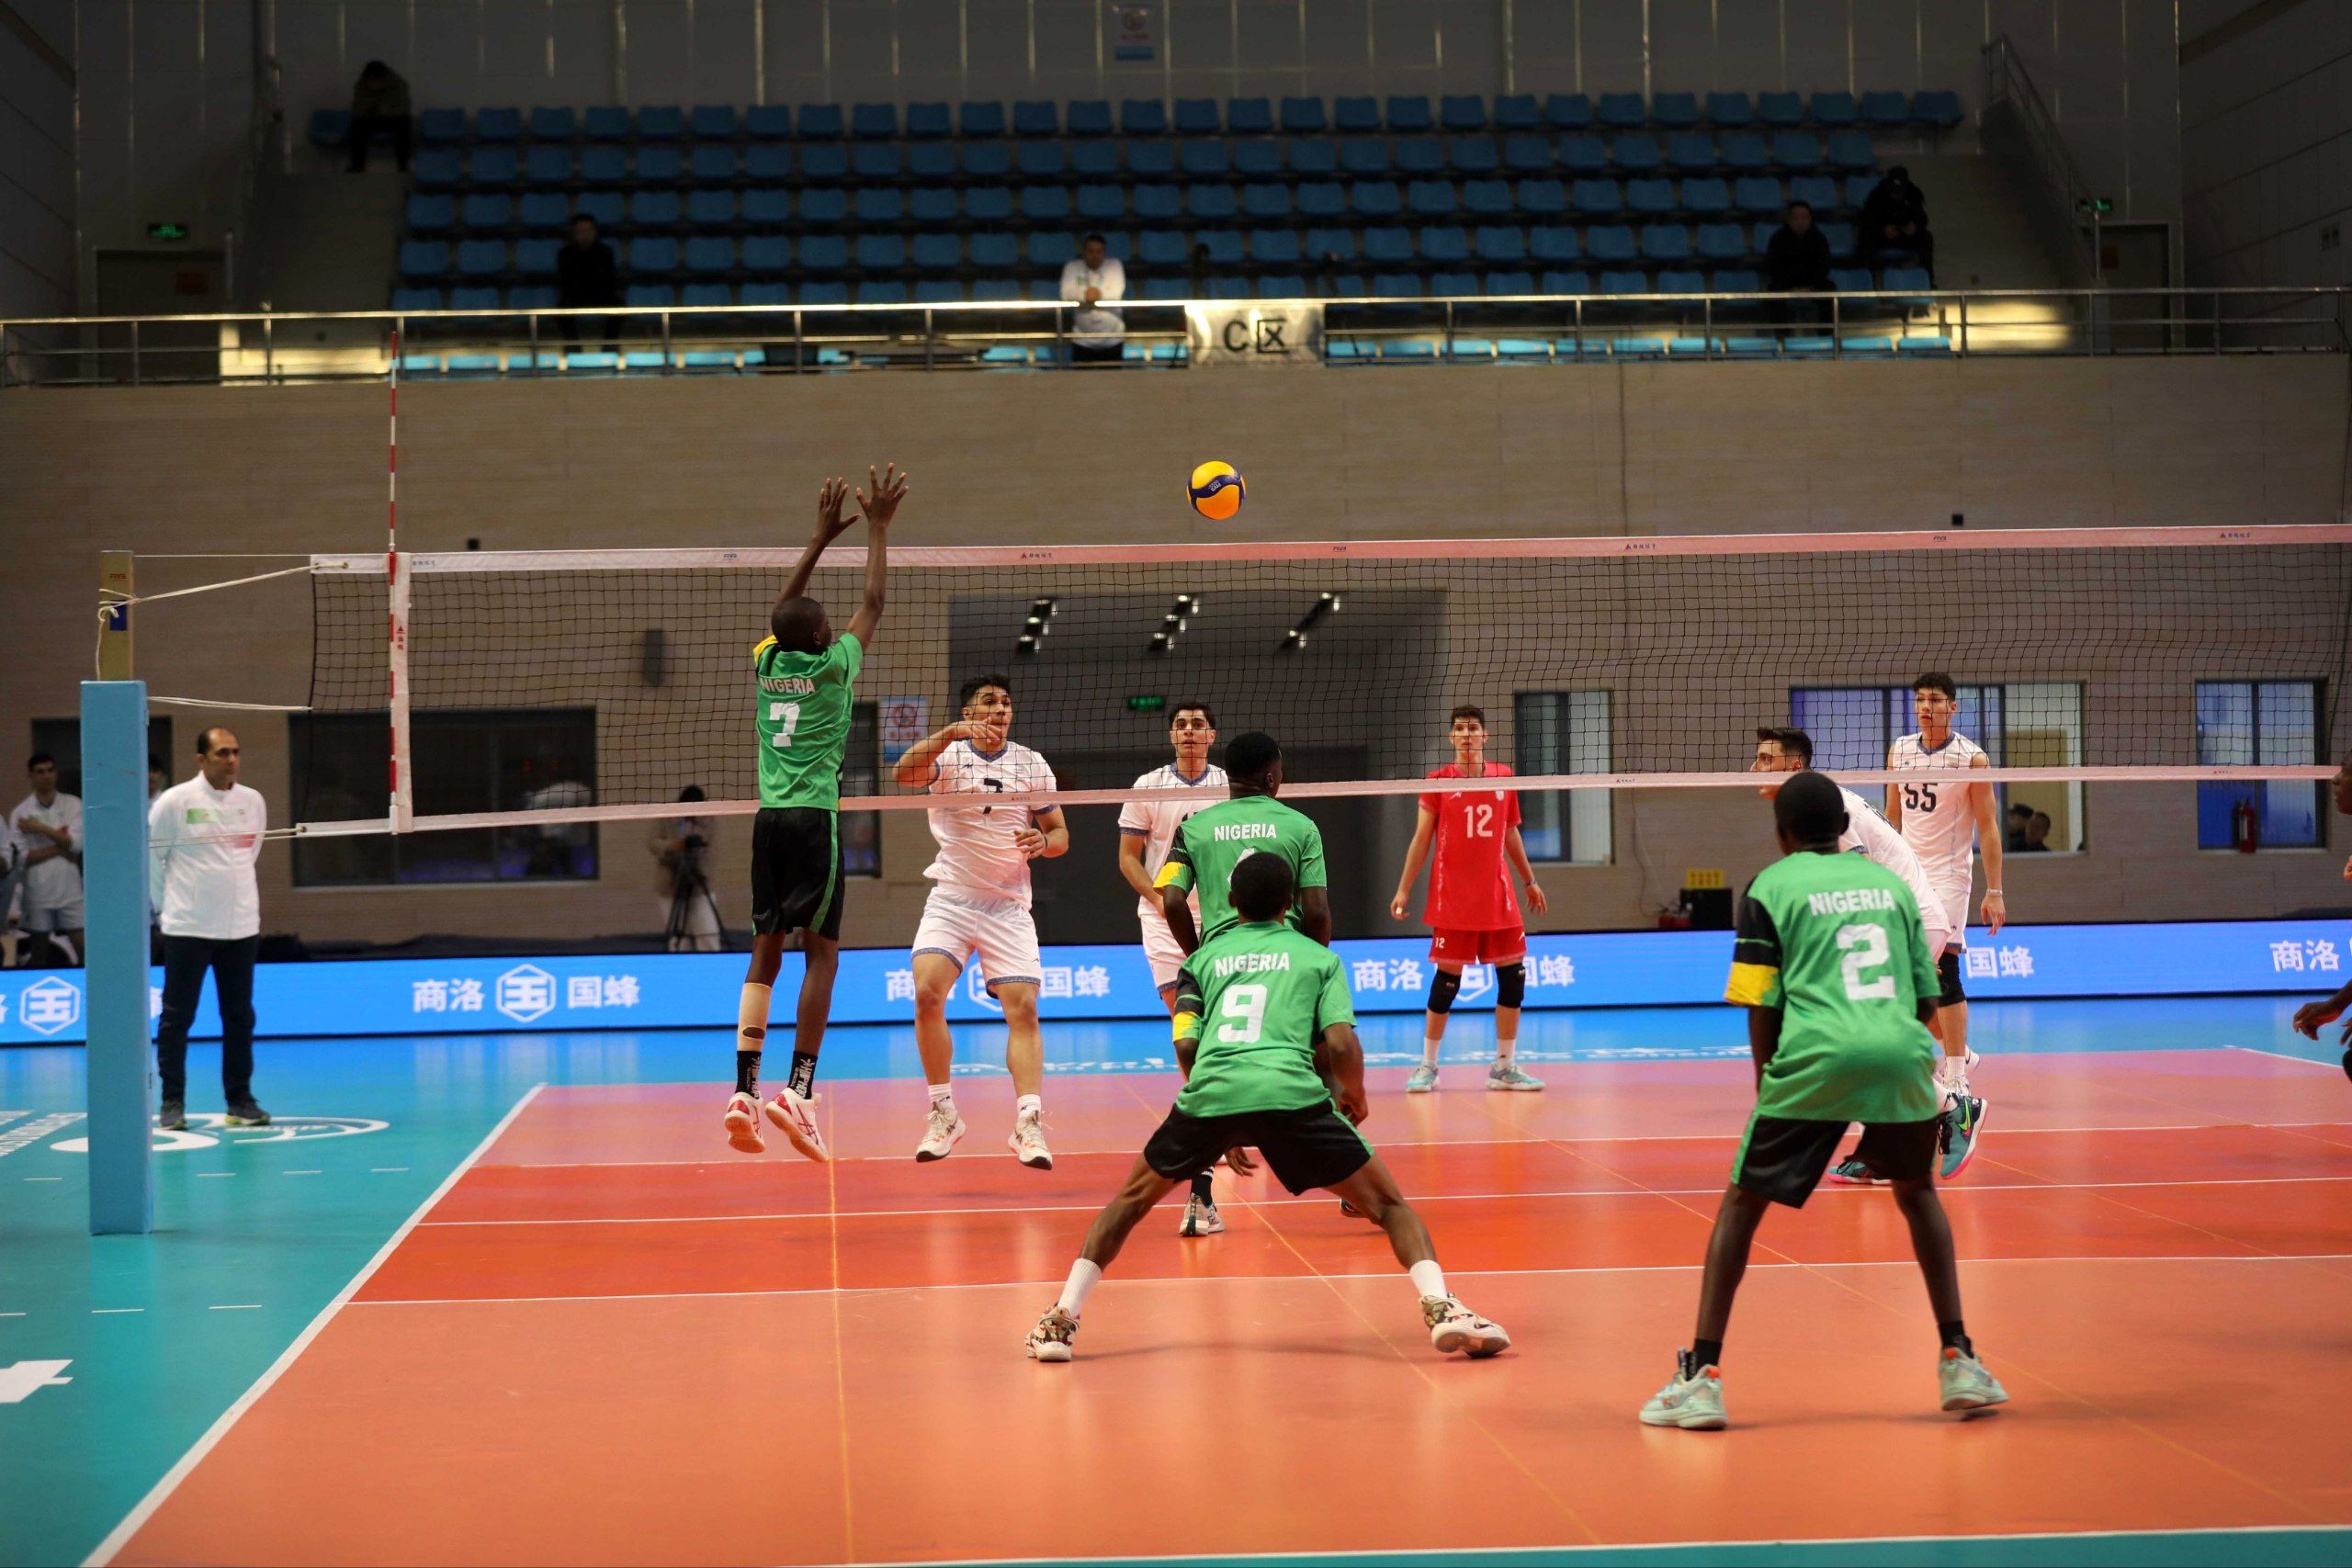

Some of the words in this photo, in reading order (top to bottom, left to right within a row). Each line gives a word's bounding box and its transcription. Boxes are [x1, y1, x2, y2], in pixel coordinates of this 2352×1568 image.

[760, 677, 816, 694] NIGERIA
[769, 702, 801, 748] 7
[1214, 823, 1277, 842] NIGERIA
[1464, 804, 1494, 839] 12
[1807, 888, 1897, 917] NIGERIA
[1435, 937, 1445, 949] 12
[2269, 939, 2340, 973] 商洛
[1215, 952, 1291, 978] NIGERIA
[1352, 958, 1423, 992] 商洛
[1836, 922, 1896, 1000] 2
[1965, 945, 2034, 978] 国蜂
[413, 978, 485, 1013] 商洛
[567, 975, 641, 1010] 国蜂
[1040, 965, 1111, 998] 国蜂
[1217, 984, 1268, 1043] 9
